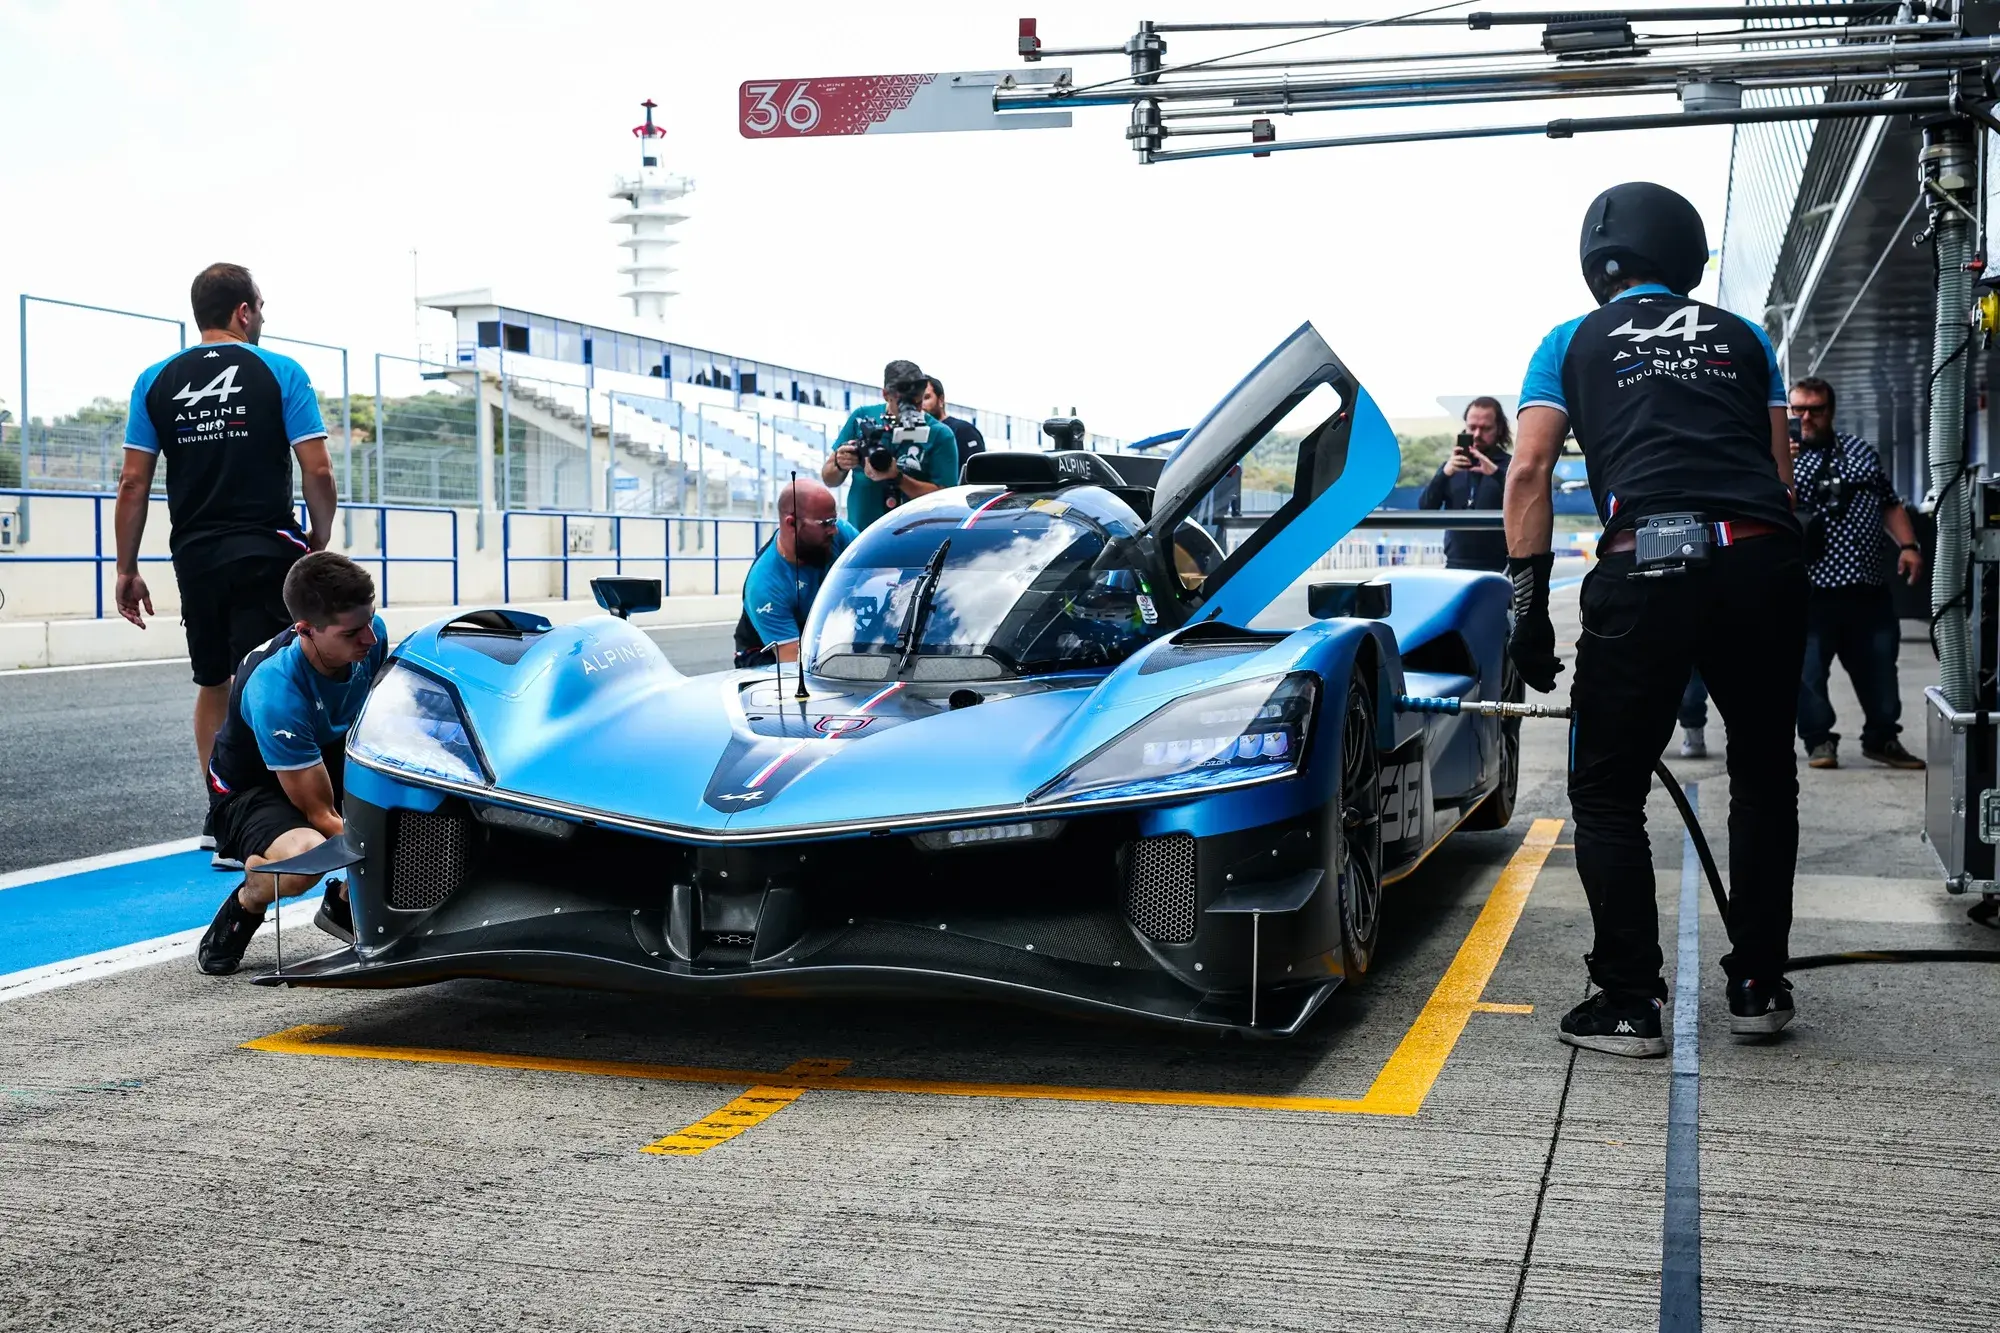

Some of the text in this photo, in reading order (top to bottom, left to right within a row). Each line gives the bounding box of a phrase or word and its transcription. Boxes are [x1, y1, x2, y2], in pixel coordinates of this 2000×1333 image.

[745, 81, 822, 134] 36
[1612, 344, 1731, 361] ALPINE
[1652, 358, 1680, 371] elf
[1617, 368, 1738, 388] ENDURANCE TEAM
[174, 406, 247, 422] ALPINE
[196, 420, 215, 432] elf
[177, 432, 224, 444] ENDURANCE
[1058, 457, 1091, 475] ALPINE
[581, 642, 646, 675] ALPINE
